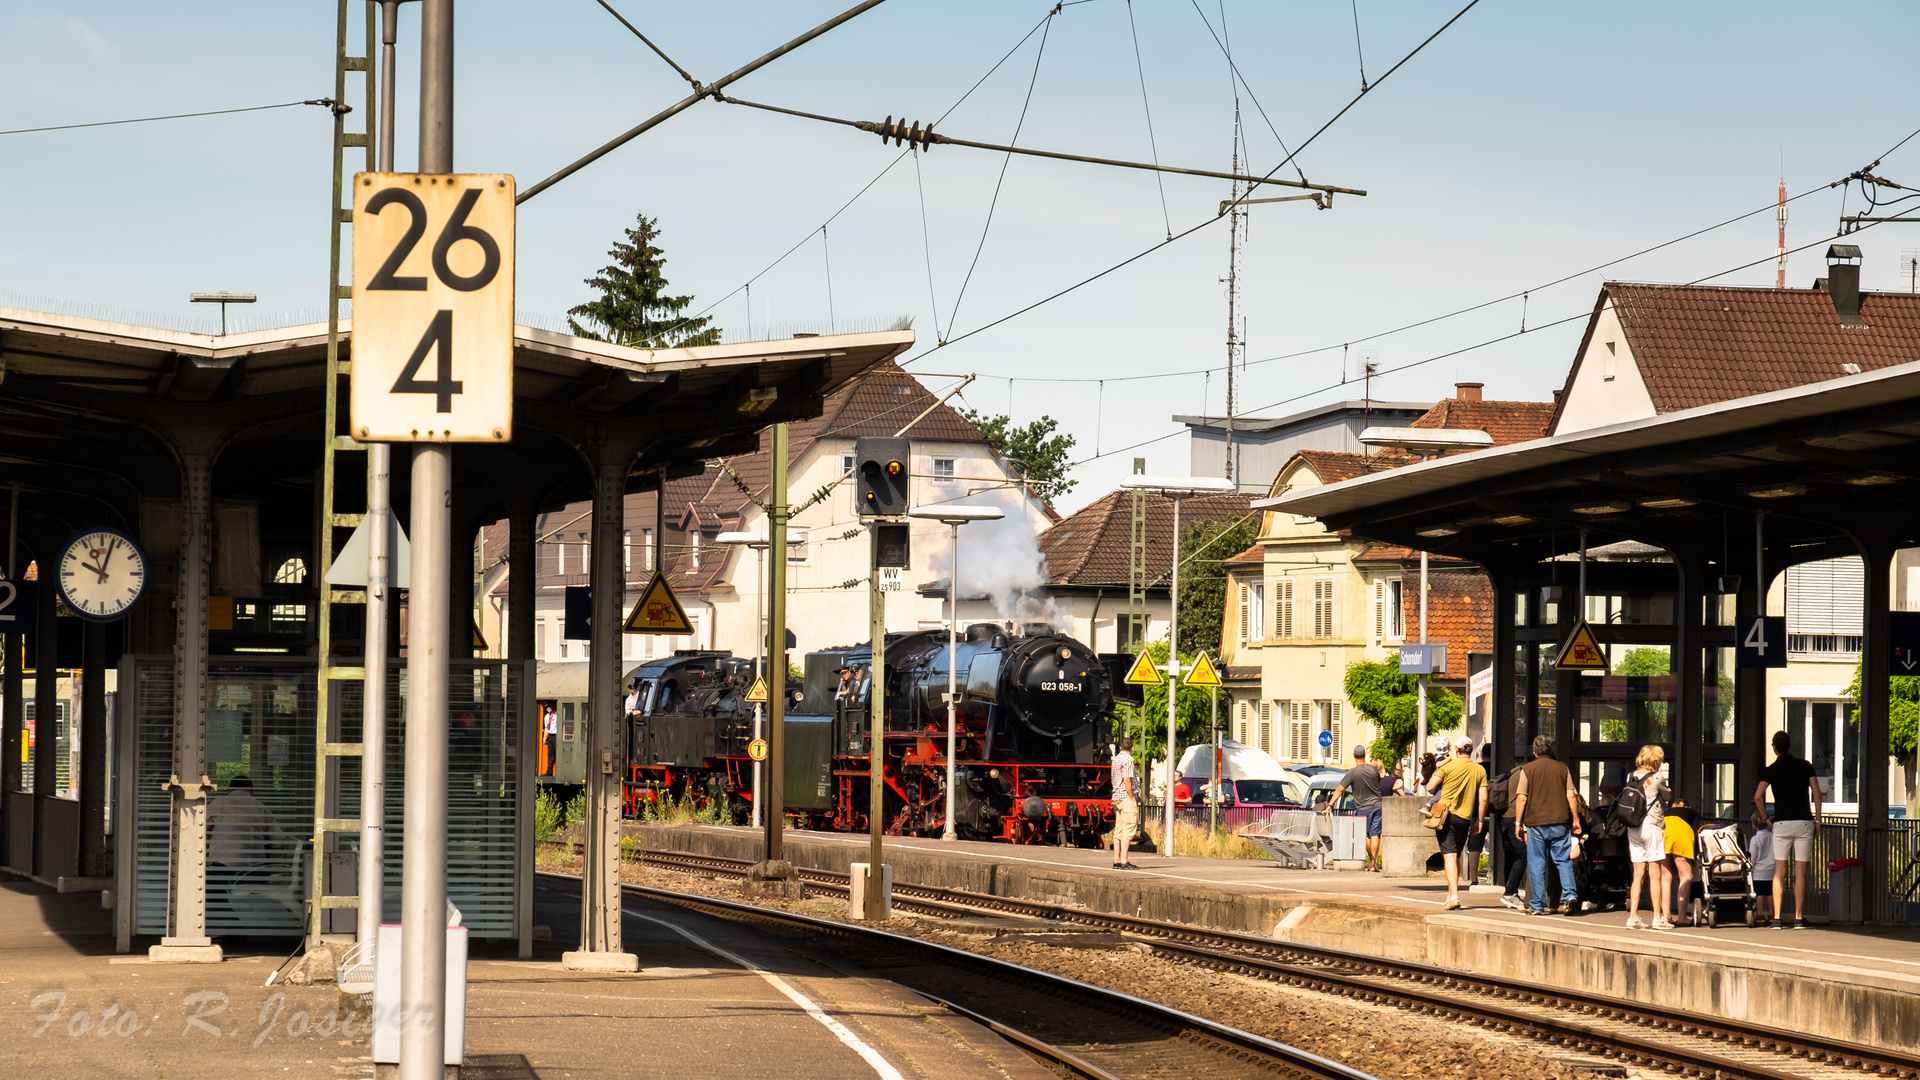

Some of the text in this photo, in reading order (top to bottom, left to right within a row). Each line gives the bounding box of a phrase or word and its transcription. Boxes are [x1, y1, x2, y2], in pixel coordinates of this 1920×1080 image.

[364, 187, 501, 292] 26
[388, 309, 464, 413] 4
[884, 568, 898, 579] WV
[0, 580, 17, 621] 2
[1744, 617, 1769, 656] 4
[1041, 681, 1082, 692] 023 058-1
